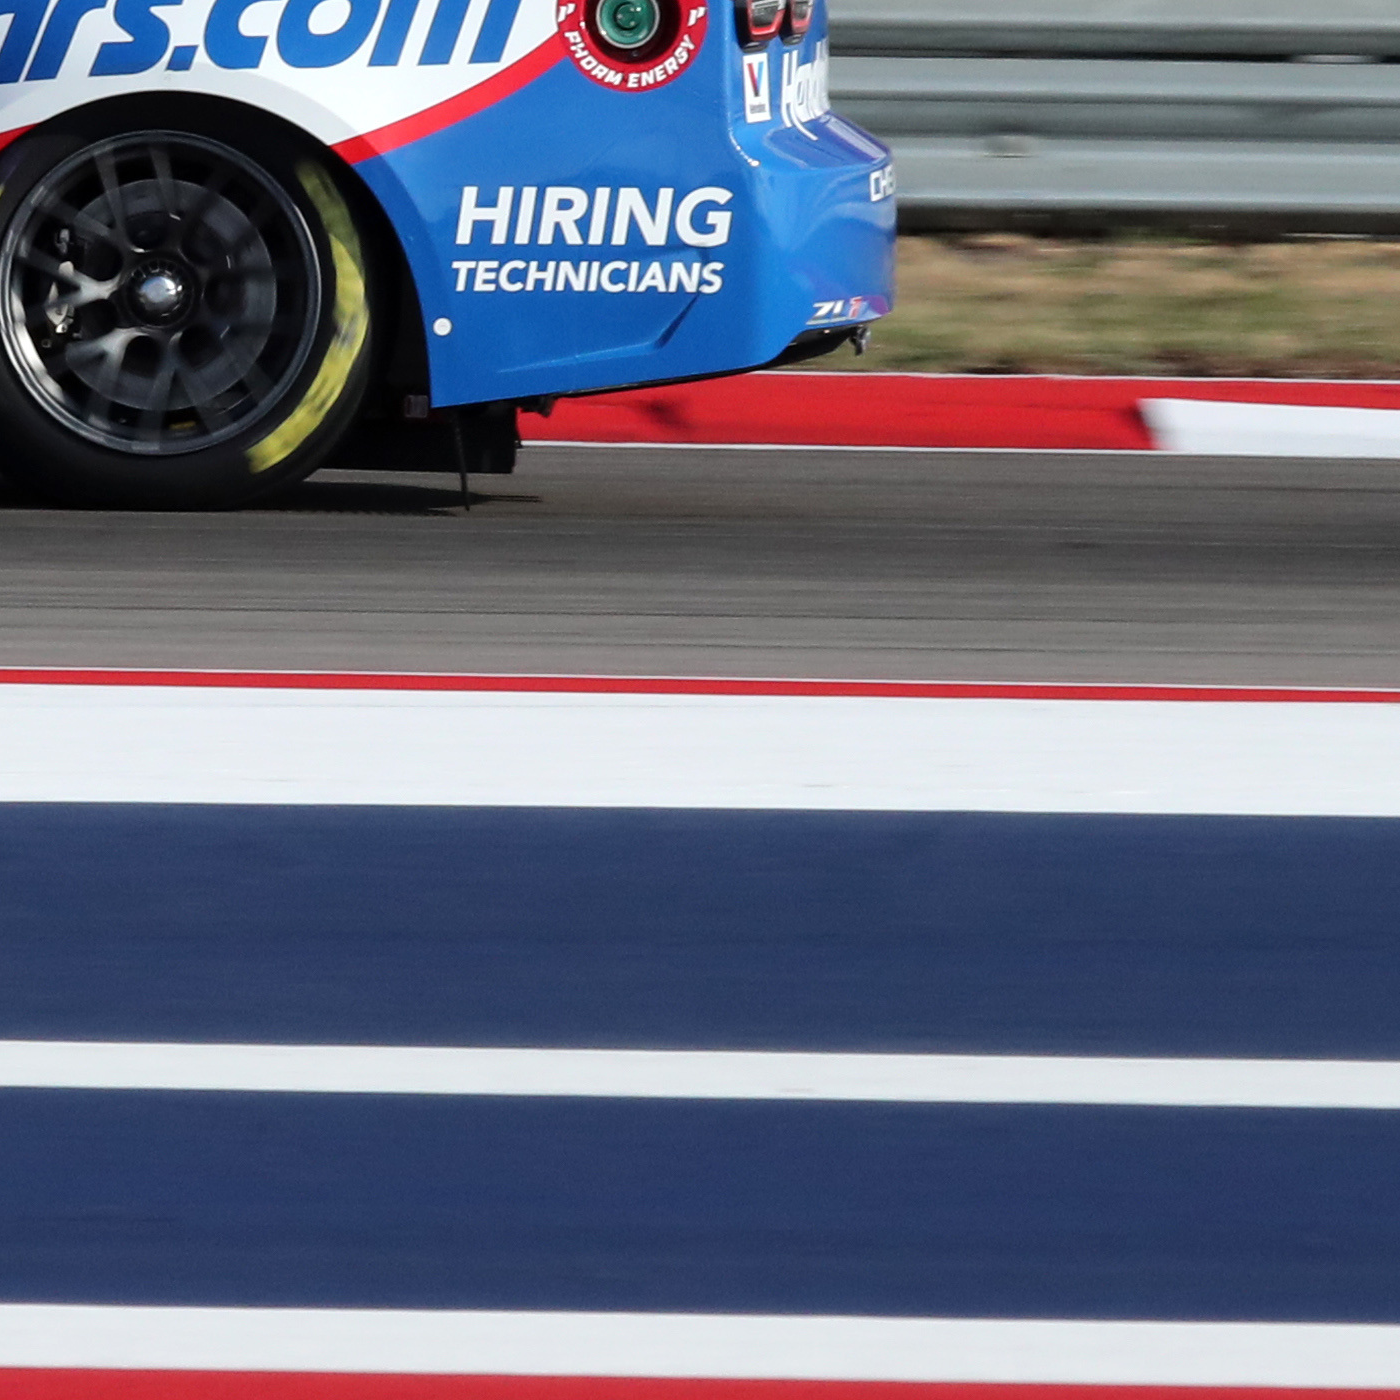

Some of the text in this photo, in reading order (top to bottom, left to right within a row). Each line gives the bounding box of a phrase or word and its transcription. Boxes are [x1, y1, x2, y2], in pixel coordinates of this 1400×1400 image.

[563, 30, 623, 86] PHORM
[454, 185, 735, 248] HIRING
[451, 260, 726, 295] TECHNICIANS
